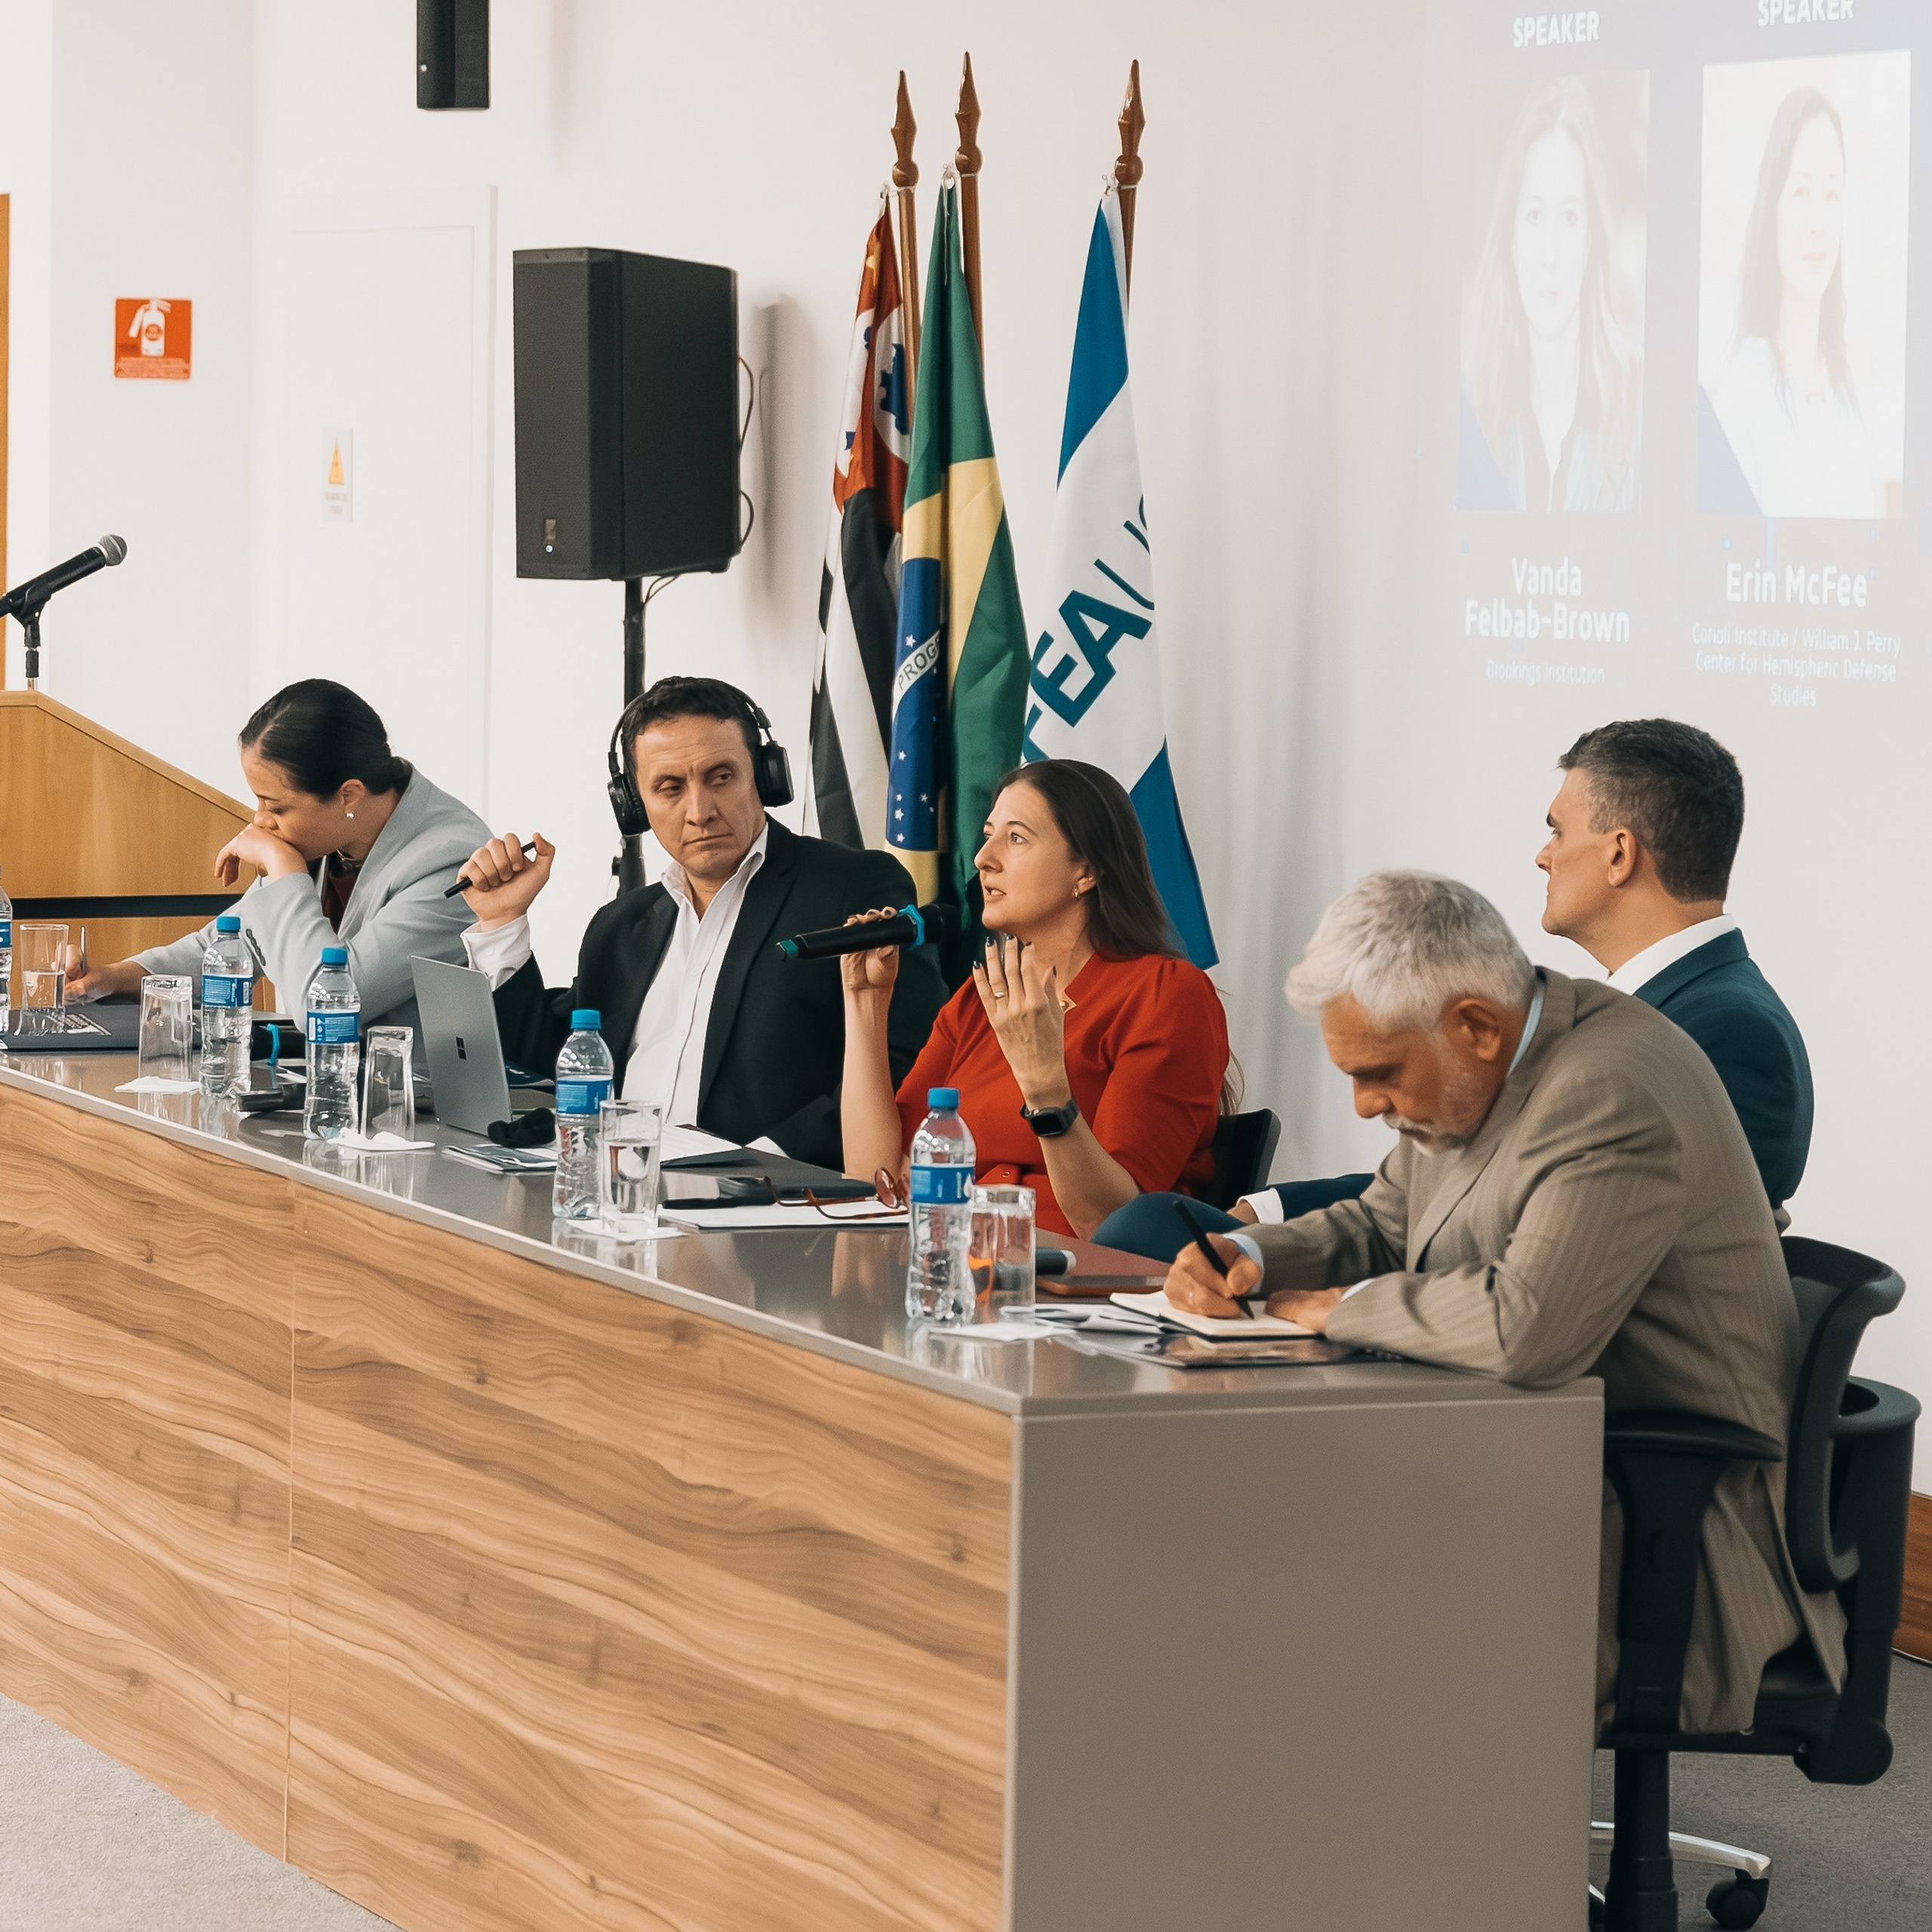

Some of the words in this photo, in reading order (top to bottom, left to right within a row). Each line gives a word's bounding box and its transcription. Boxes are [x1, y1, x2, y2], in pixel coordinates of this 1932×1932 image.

[1512, 11, 1600, 48] SPEAKER
[1758, 0, 1854, 26] SPEAKER
[1512, 556, 1582, 596] Vanda
[1726, 558, 1777, 603] Erin
[1785, 565, 1868, 607] McFee
[1465, 598, 1629, 642] Felbab-Brown
[1692, 623, 1731, 646] Corioli
[1735, 624, 1788, 650] Institute
[1802, 628, 1849, 653] William
[1854, 629, 1862, 652] J.
[1866, 631, 1901, 658] Perry
[898, 635, 940, 691] PROG
[1486, 657, 1542, 686] Brookings
[1545, 658, 1605, 684] Institution
[1695, 650, 1737, 674] Center
[1740, 652, 1758, 674] for
[1763, 654, 1839, 681] Hemispheric
[1843, 658, 1897, 682] Defense
[1770, 683, 1817, 708] Studies
